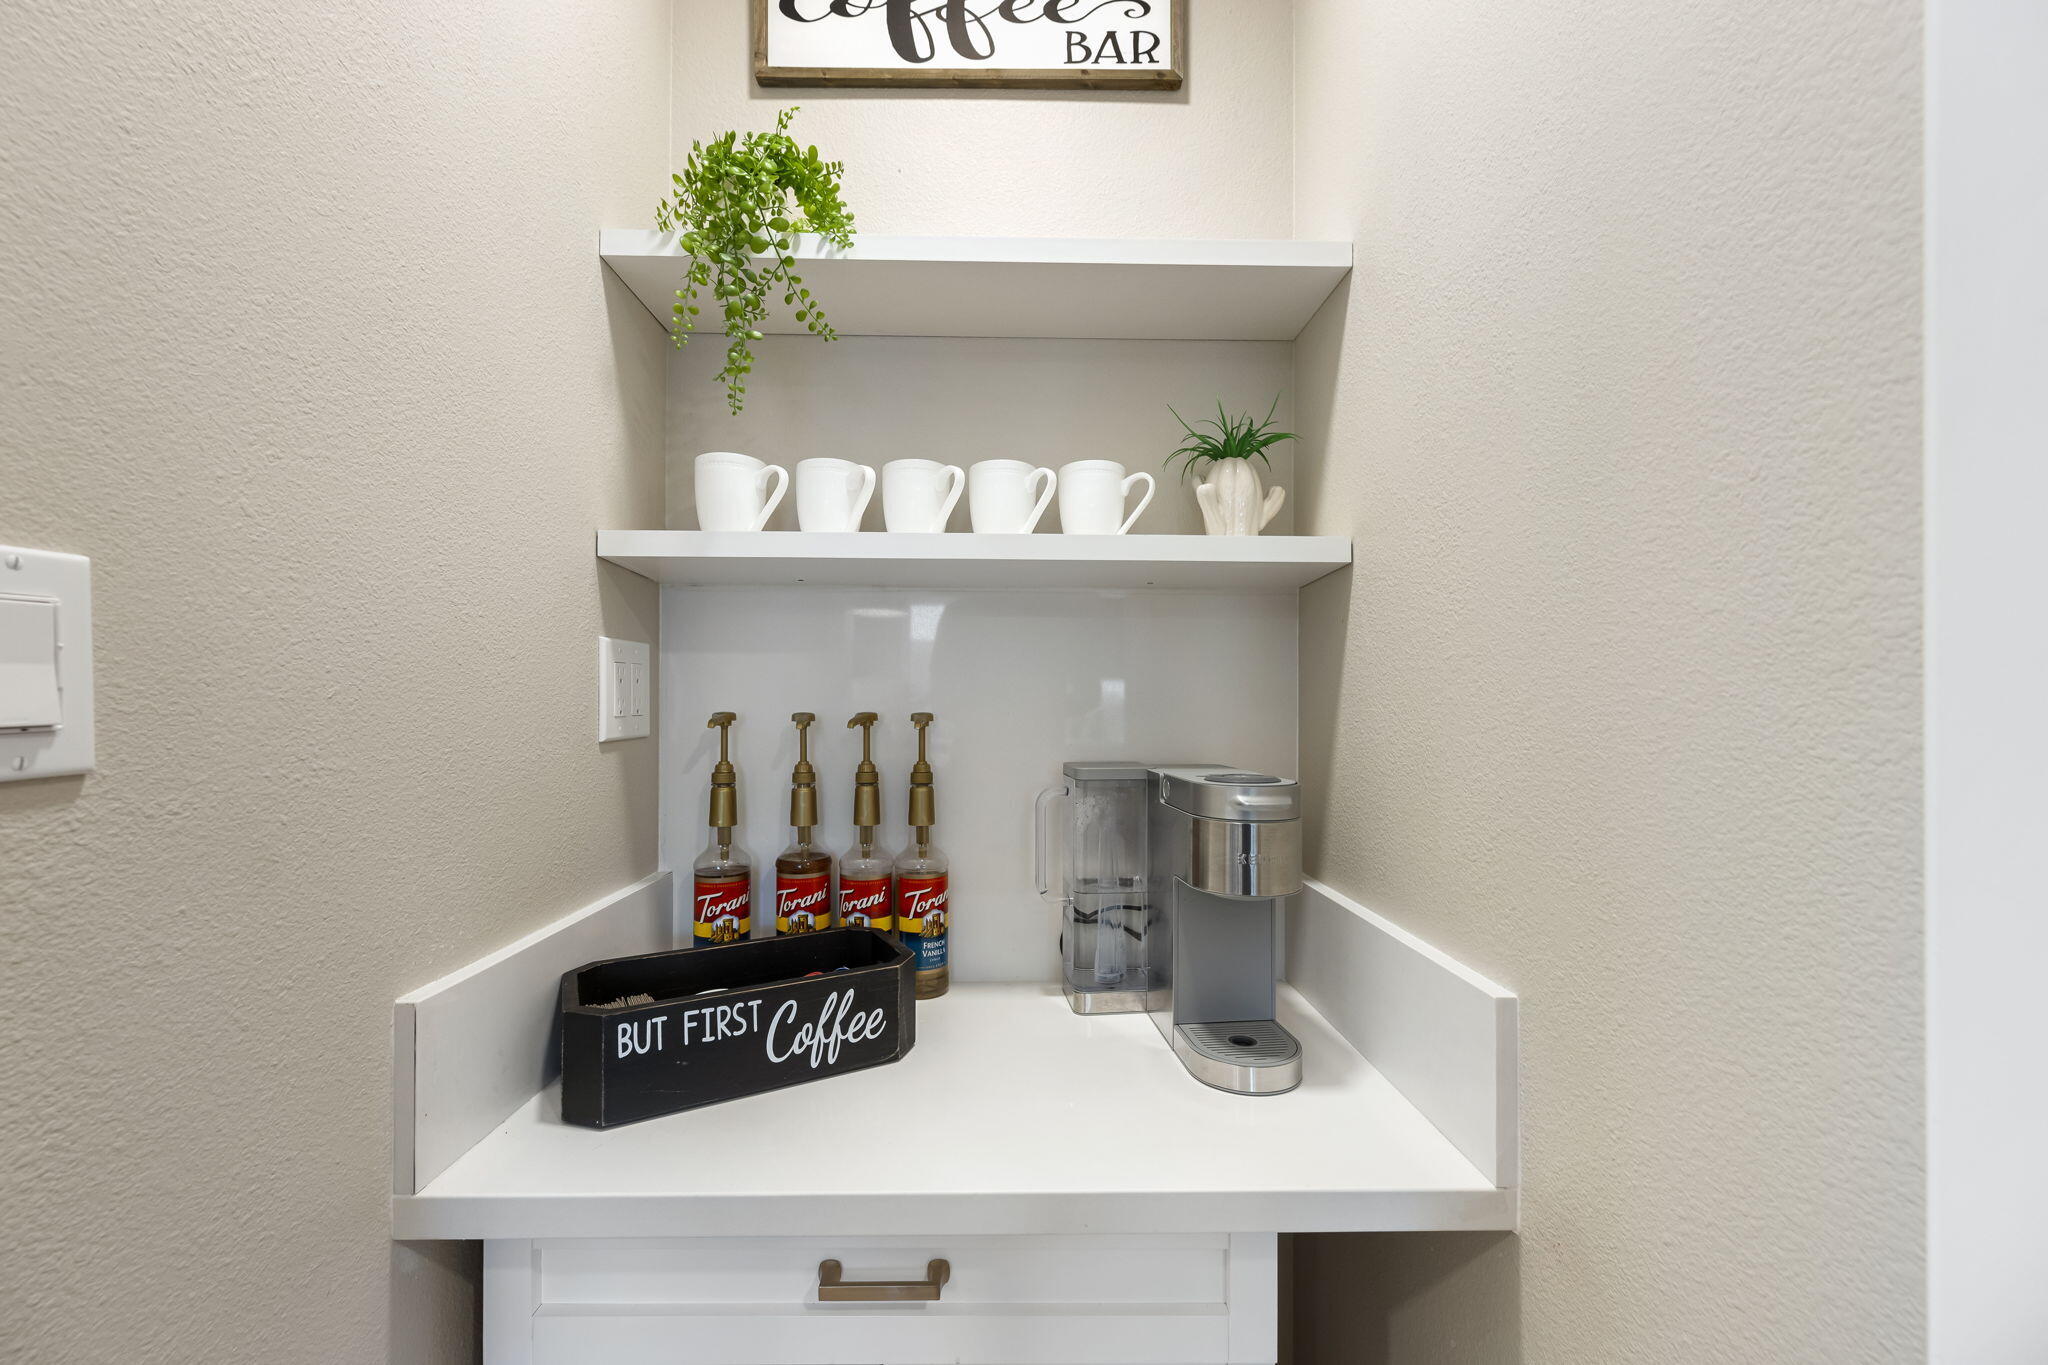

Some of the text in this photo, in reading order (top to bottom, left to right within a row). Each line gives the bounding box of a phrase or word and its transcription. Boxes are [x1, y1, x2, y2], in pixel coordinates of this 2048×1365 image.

[1064, 30, 1160, 64] BAR
[697, 886, 750, 924] Torani
[777, 882, 828, 918] Torani
[840, 886, 886, 917] Torani
[617, 988, 887, 1069] BUT FIRST Coffee
